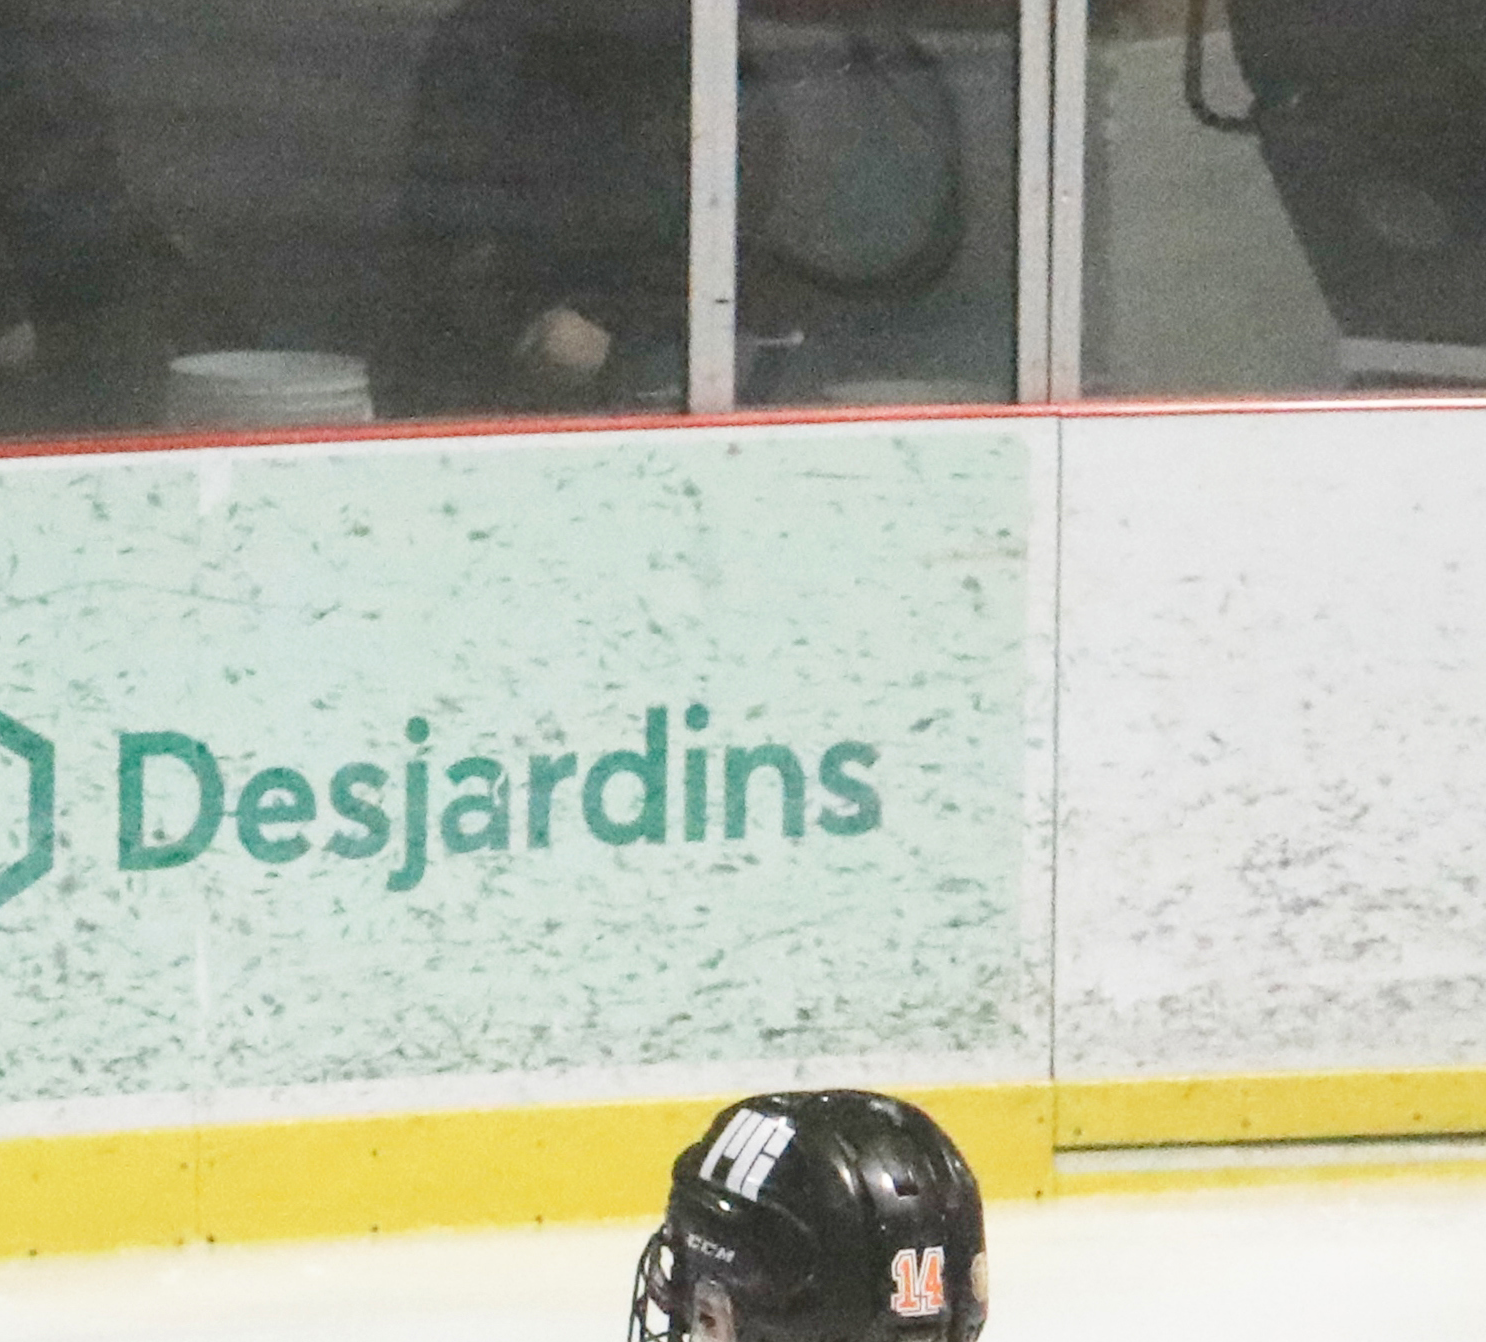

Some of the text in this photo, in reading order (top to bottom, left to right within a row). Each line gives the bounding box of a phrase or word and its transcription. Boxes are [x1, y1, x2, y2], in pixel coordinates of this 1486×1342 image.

[117, 701, 882, 892] Desjardins
[685, 1232, 736, 1264] CCM
[890, 1245, 946, 1318] 14
